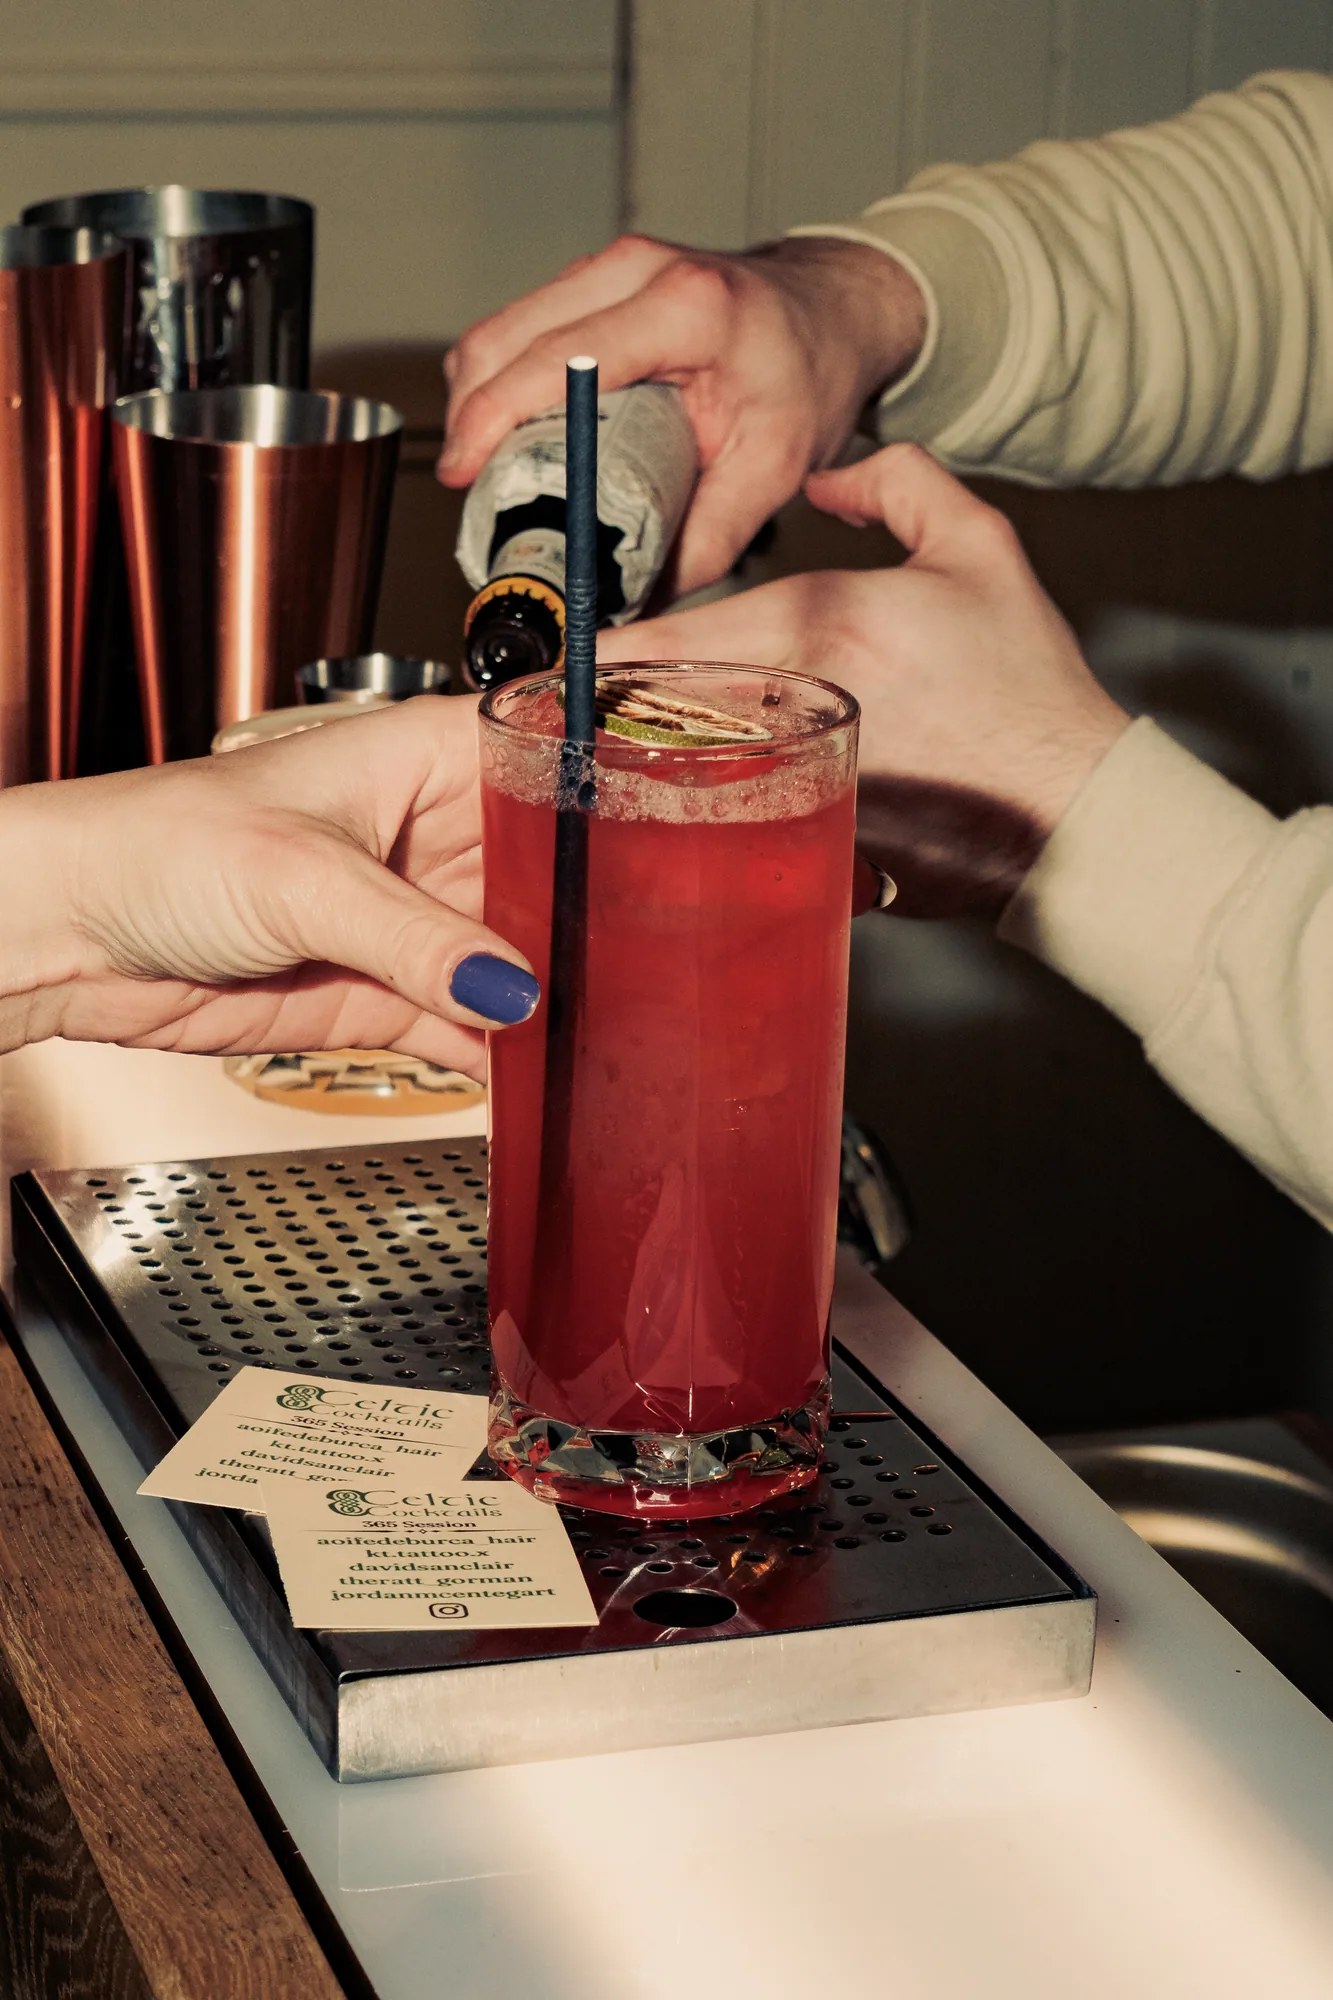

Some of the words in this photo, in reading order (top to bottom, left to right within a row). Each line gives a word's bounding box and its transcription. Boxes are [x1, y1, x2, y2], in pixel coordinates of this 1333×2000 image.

[318, 1389, 454, 1419] Celtic
[309, 1404, 444, 1430] Cocktails
[290, 1415, 326, 1427] 365
[330, 1421, 405, 1438] Session
[236, 1423, 443, 1457] aoifedeburca_hair
[269, 1439, 386, 1464] kt.tattoo.x
[240, 1449, 396, 1478] davidsanclair
[362, 1489, 502, 1507] Celtic
[366, 1505, 503, 1518] Cocktails
[361, 1520, 398, 1529] 365
[402, 1520, 477, 1529] Session
[317, 1535, 537, 1547] aoifedeburca_hair
[366, 1549, 490, 1559] kt.tattoo.x
[349, 1561, 515, 1573] davidsanclair
[338, 1574, 533, 1587] theratt_gorman
[331, 1587, 557, 1602] jordanmcentegart
